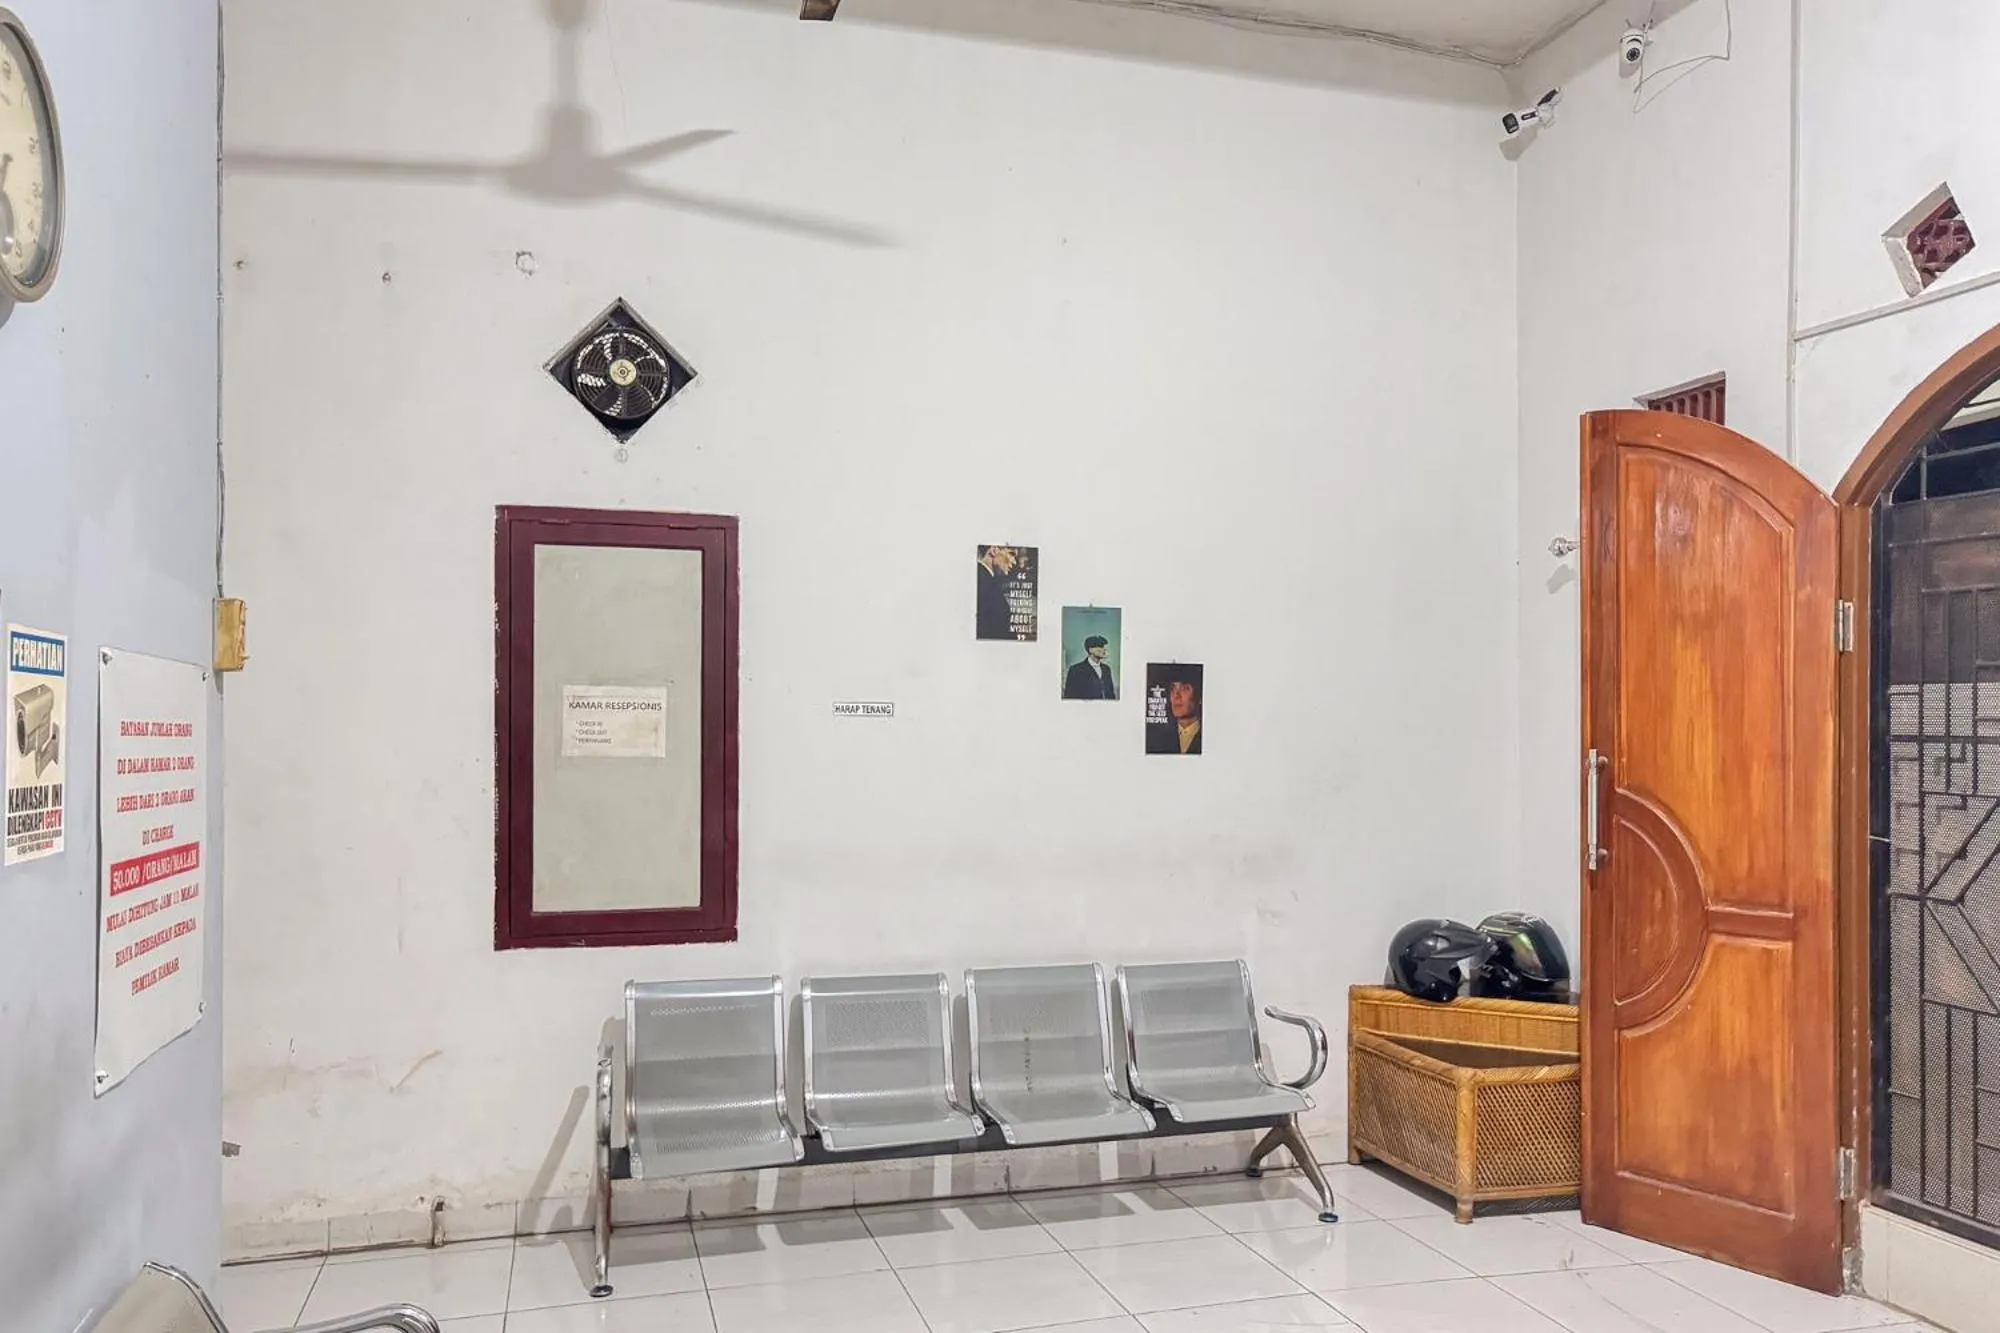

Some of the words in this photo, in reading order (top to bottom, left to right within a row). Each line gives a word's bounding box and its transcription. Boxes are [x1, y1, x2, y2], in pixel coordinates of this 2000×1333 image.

[12, 637, 64, 672] PERHATIAN
[568, 701, 603, 711] KAMAR
[605, 701, 662, 712] RESEPSIONIS
[835, 705, 860, 714] HARAP
[861, 704, 891, 714] TENANG
[117, 759, 127, 776] DI
[127, 758, 149, 774] DALAM
[8, 785, 49, 814] KAWASAN
[7, 810, 44, 837] DILENGKAPI
[44, 809, 62, 830] CCTV
[112, 865, 140, 892] 50.000
